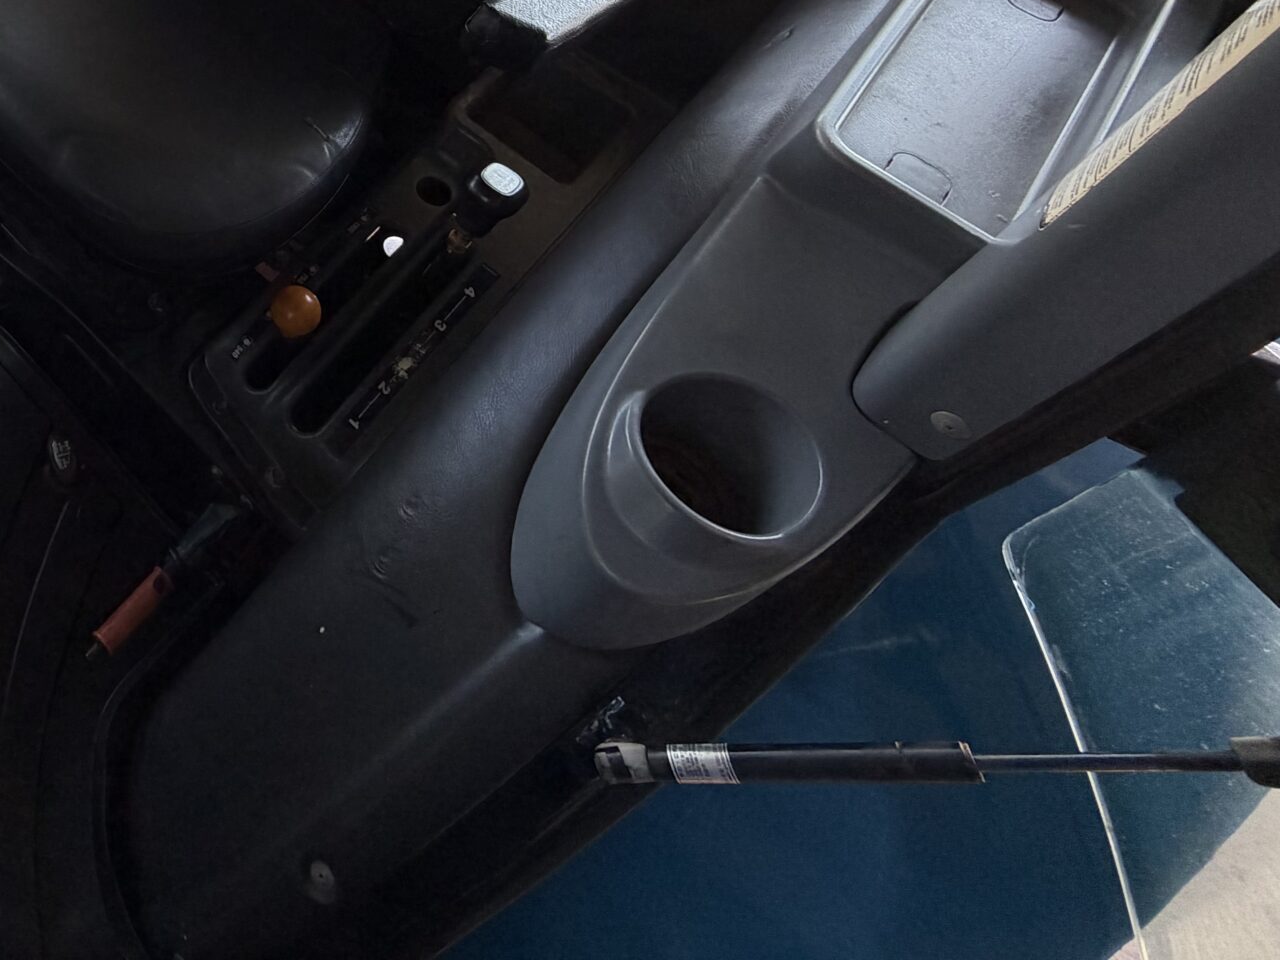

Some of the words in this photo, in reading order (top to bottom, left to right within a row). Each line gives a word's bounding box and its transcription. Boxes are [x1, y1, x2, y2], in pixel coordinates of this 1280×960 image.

[464, 286, 476, 298] 4
[434, 319, 447, 332] 3
[378, 381, 391, 395] 2
[349, 418, 360, 430] 1
